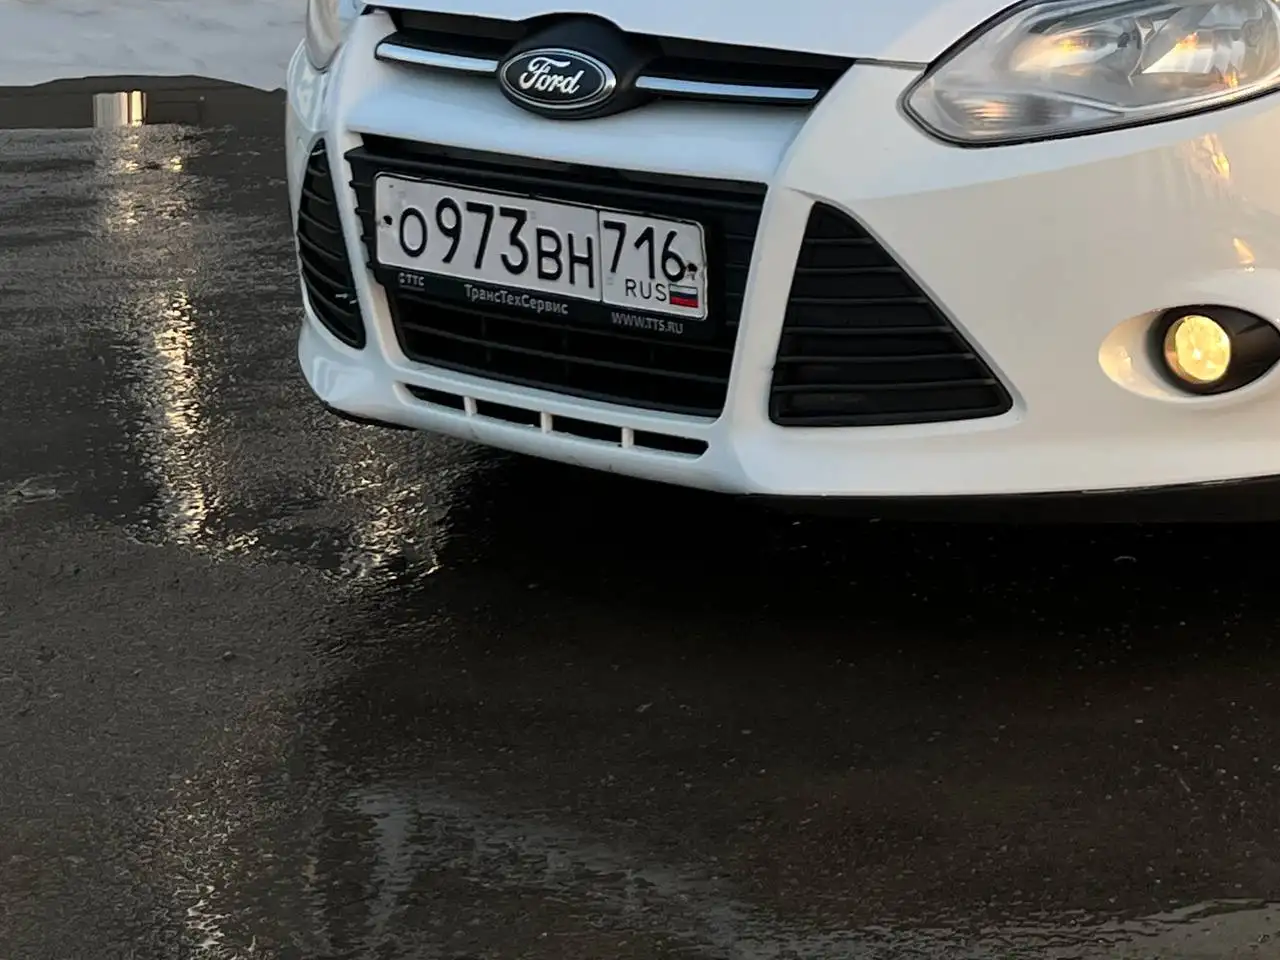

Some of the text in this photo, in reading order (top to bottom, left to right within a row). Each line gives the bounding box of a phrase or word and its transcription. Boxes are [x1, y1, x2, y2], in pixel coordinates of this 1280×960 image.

[518, 56, 586, 95] Ford
[603, 220, 686, 283] 716
[463, 283, 569, 315] ТрансТехСервис
[625, 279, 668, 302] RUS
[611, 311, 684, 334] WWW.TTS.RU
